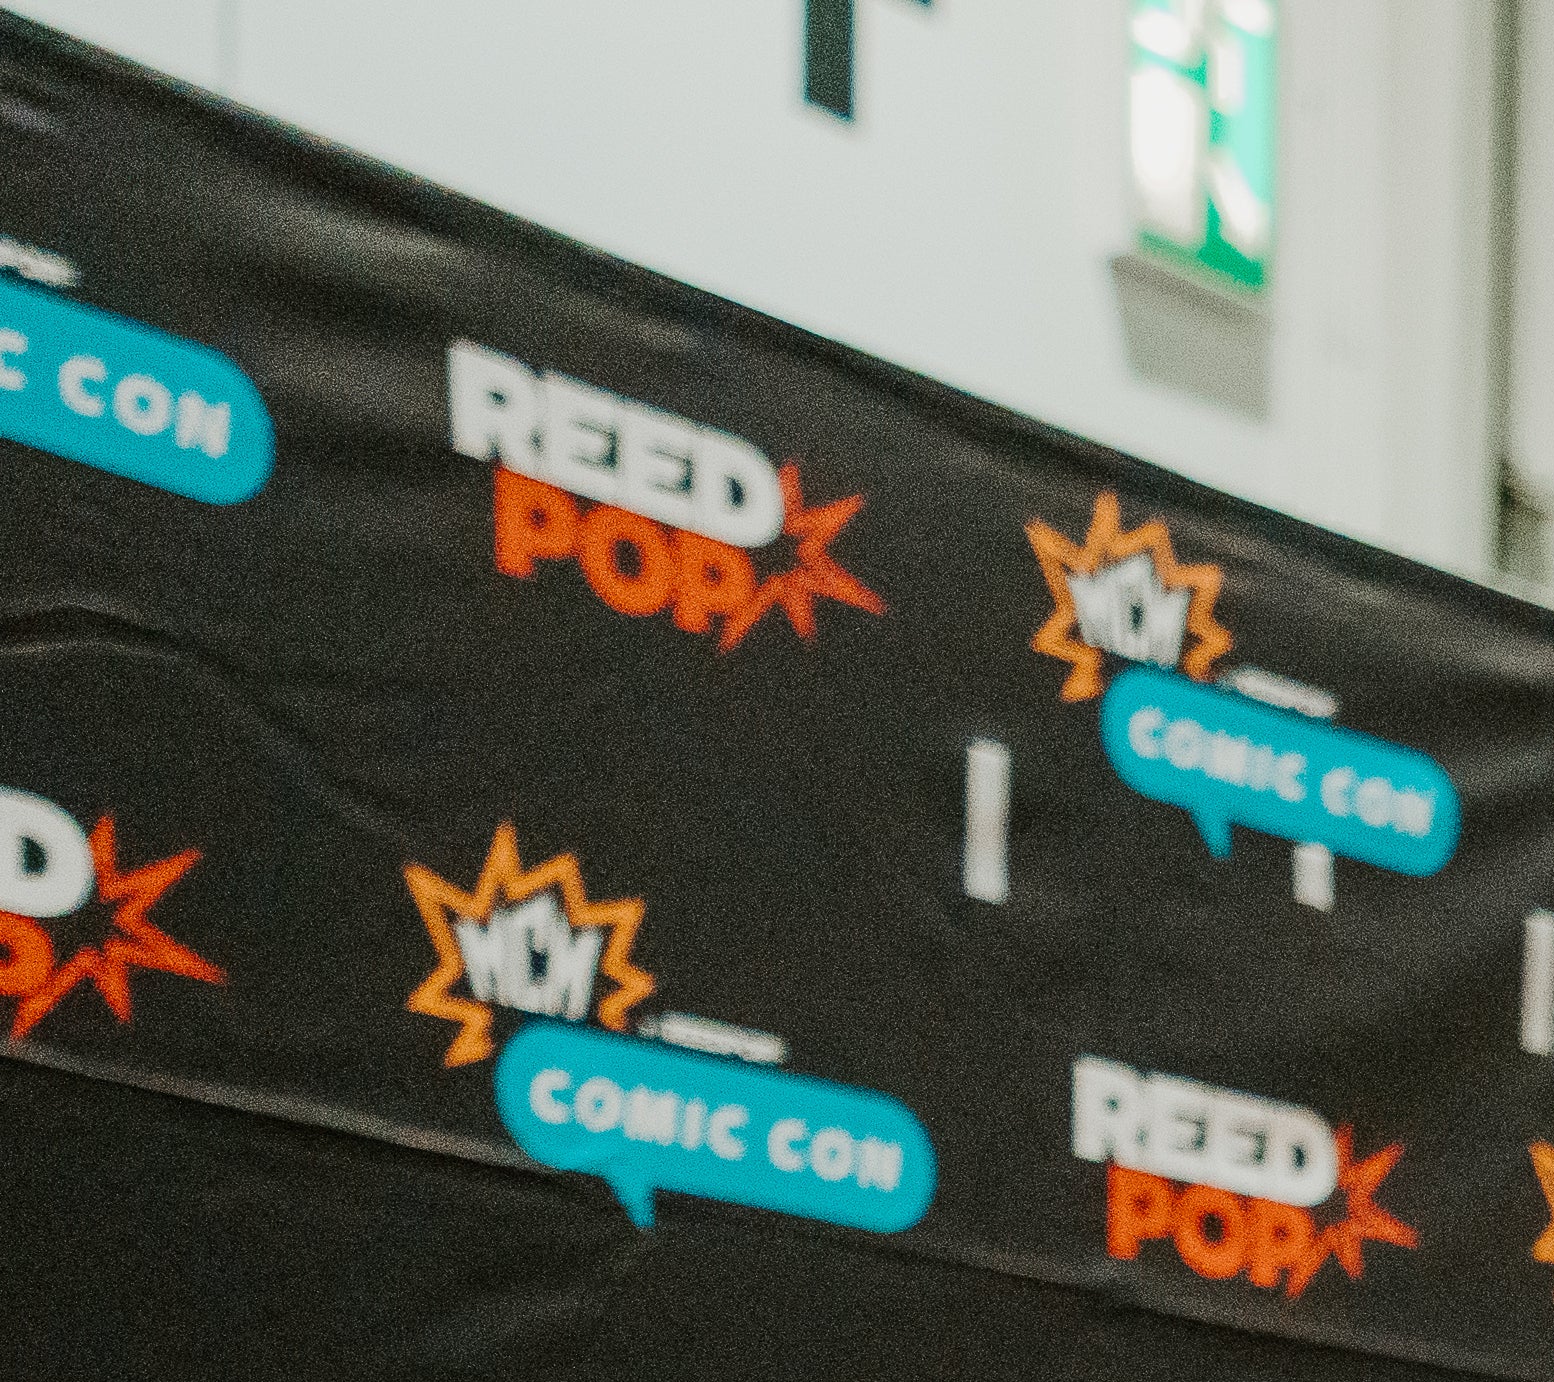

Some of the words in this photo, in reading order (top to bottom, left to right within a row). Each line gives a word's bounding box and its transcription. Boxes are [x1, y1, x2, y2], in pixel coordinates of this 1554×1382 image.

[58, 354, 233, 460] CON
[446, 337, 784, 549] REED
[493, 464, 760, 636] POP
[528, 1066, 748, 1162] COMIC
[767, 1117, 905, 1192] CON
[1070, 1053, 1340, 1209] REED
[1104, 1162, 1318, 1290] POP
